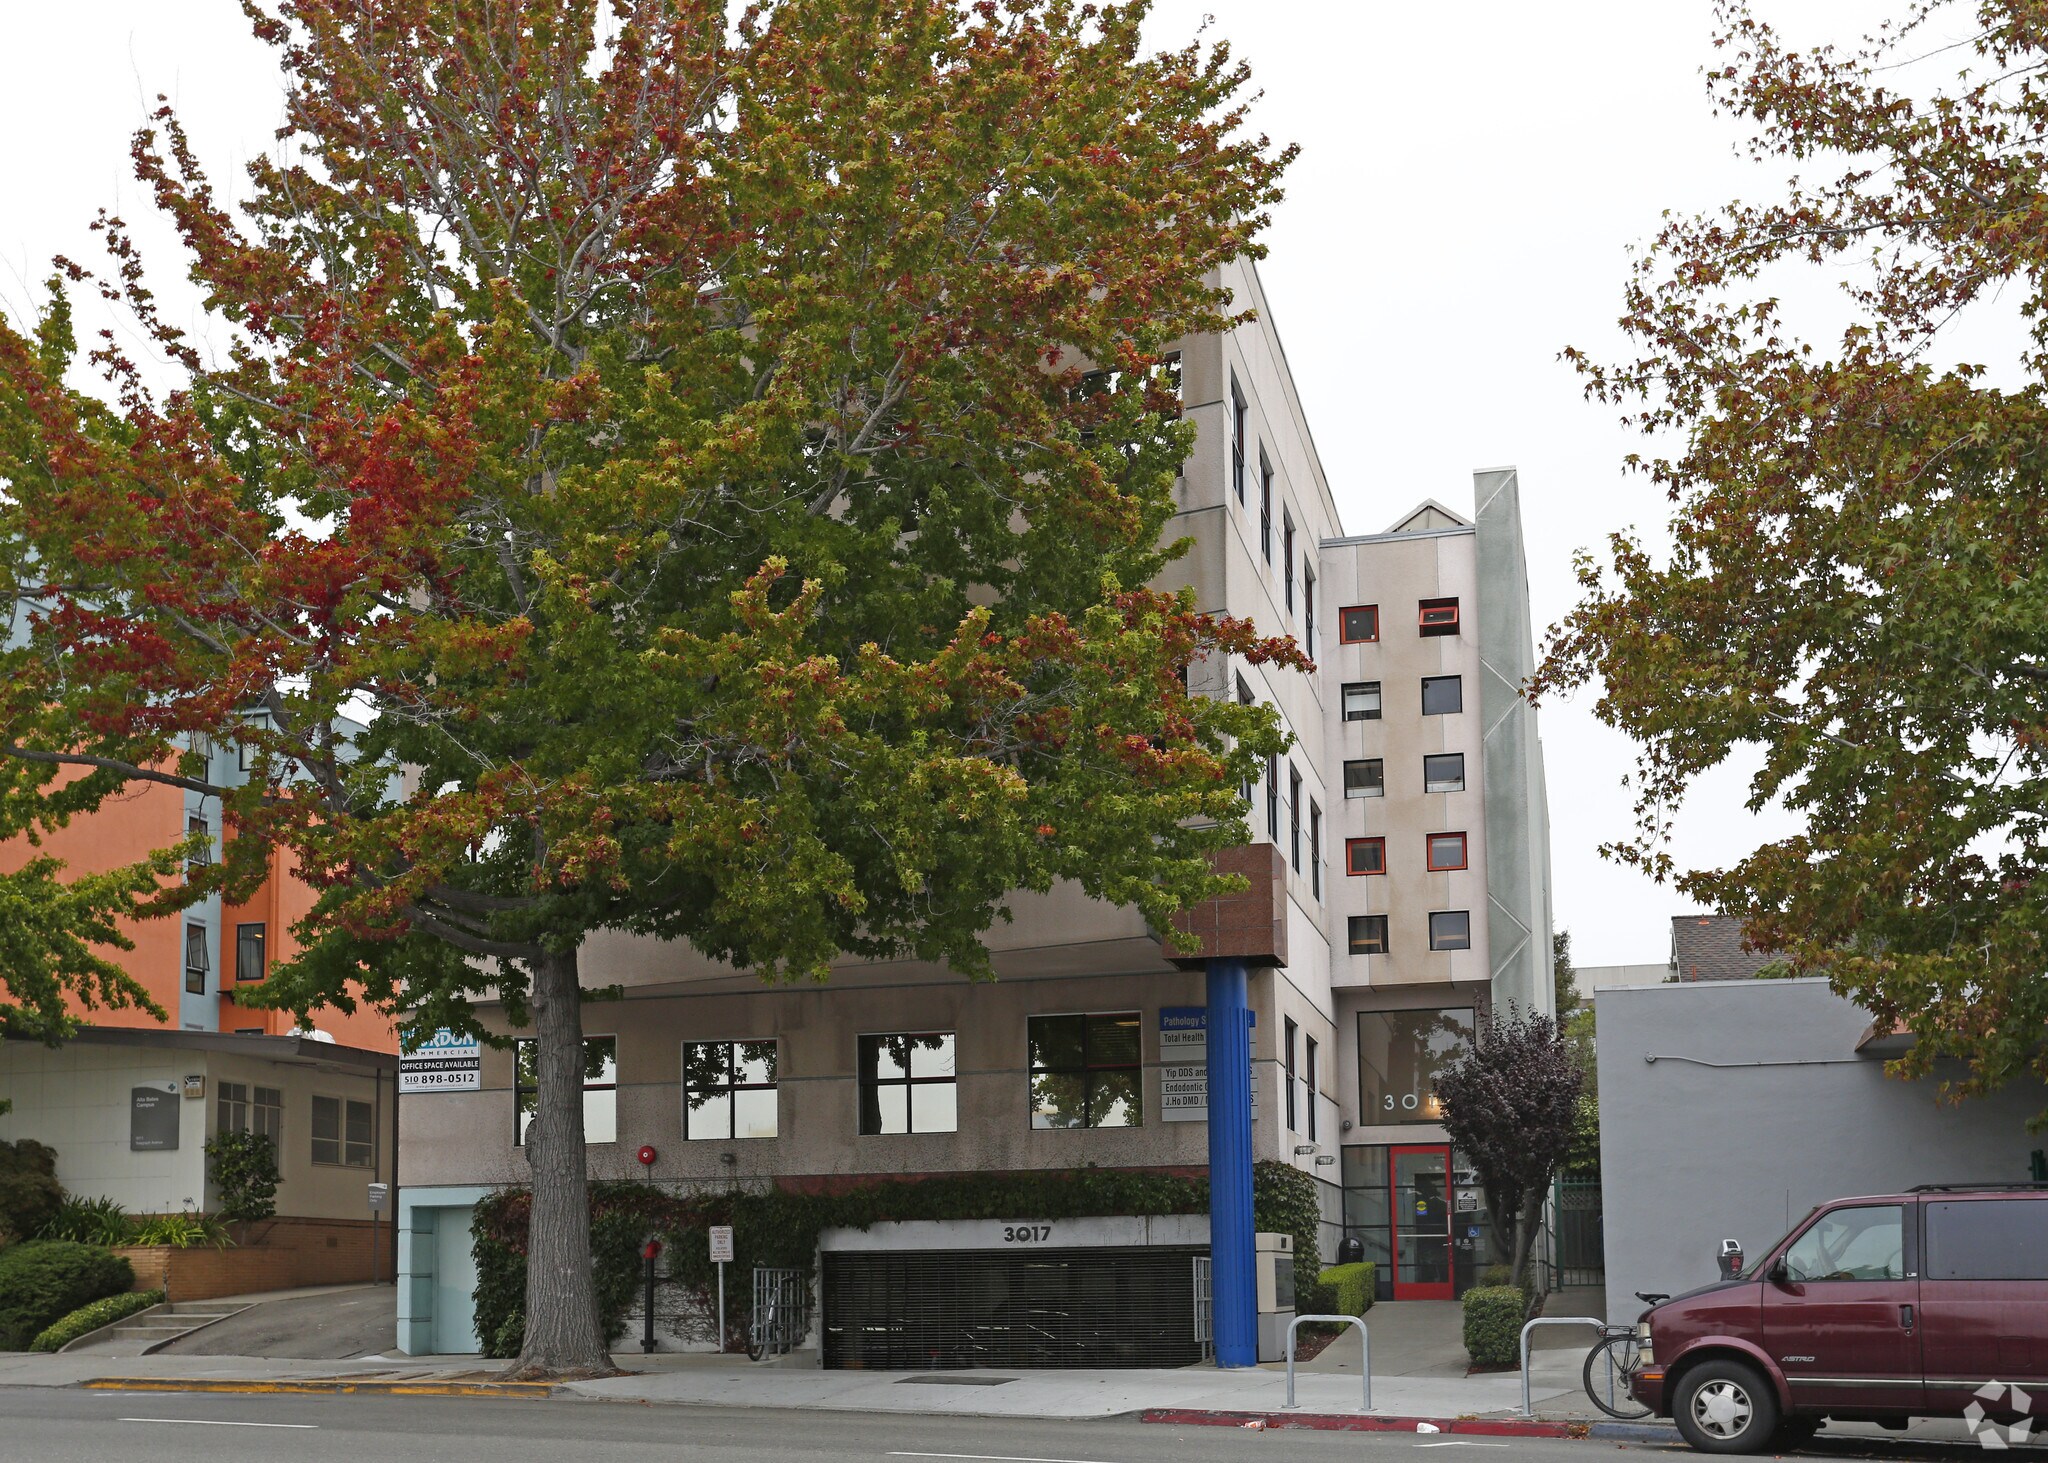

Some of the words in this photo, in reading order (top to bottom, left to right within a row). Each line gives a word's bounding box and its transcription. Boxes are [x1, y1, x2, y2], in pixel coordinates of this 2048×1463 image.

[1163, 1016, 1199, 1027] Pathology
[1163, 1033, 1180, 1043] Total
[1182, 1032, 1205, 1043] Health
[401, 1062, 423, 1070] OFFICE
[424, 1061, 443, 1069] SPACE
[444, 1060, 479, 1069] AVAILABLE
[404, 1075, 419, 1084] 510
[421, 1073, 475, 1084] 898-0512
[1165, 1068, 1177, 1079] Yip
[1178, 1068, 1194, 1077] DDS
[1165, 1082, 1203, 1093] Endodontic
[1165, 1096, 1181, 1106] J.Ho
[1182, 1095, 1199, 1106] DMD
[1383, 1093, 1434, 1111] 301
[1004, 1226, 1051, 1242] 3017
